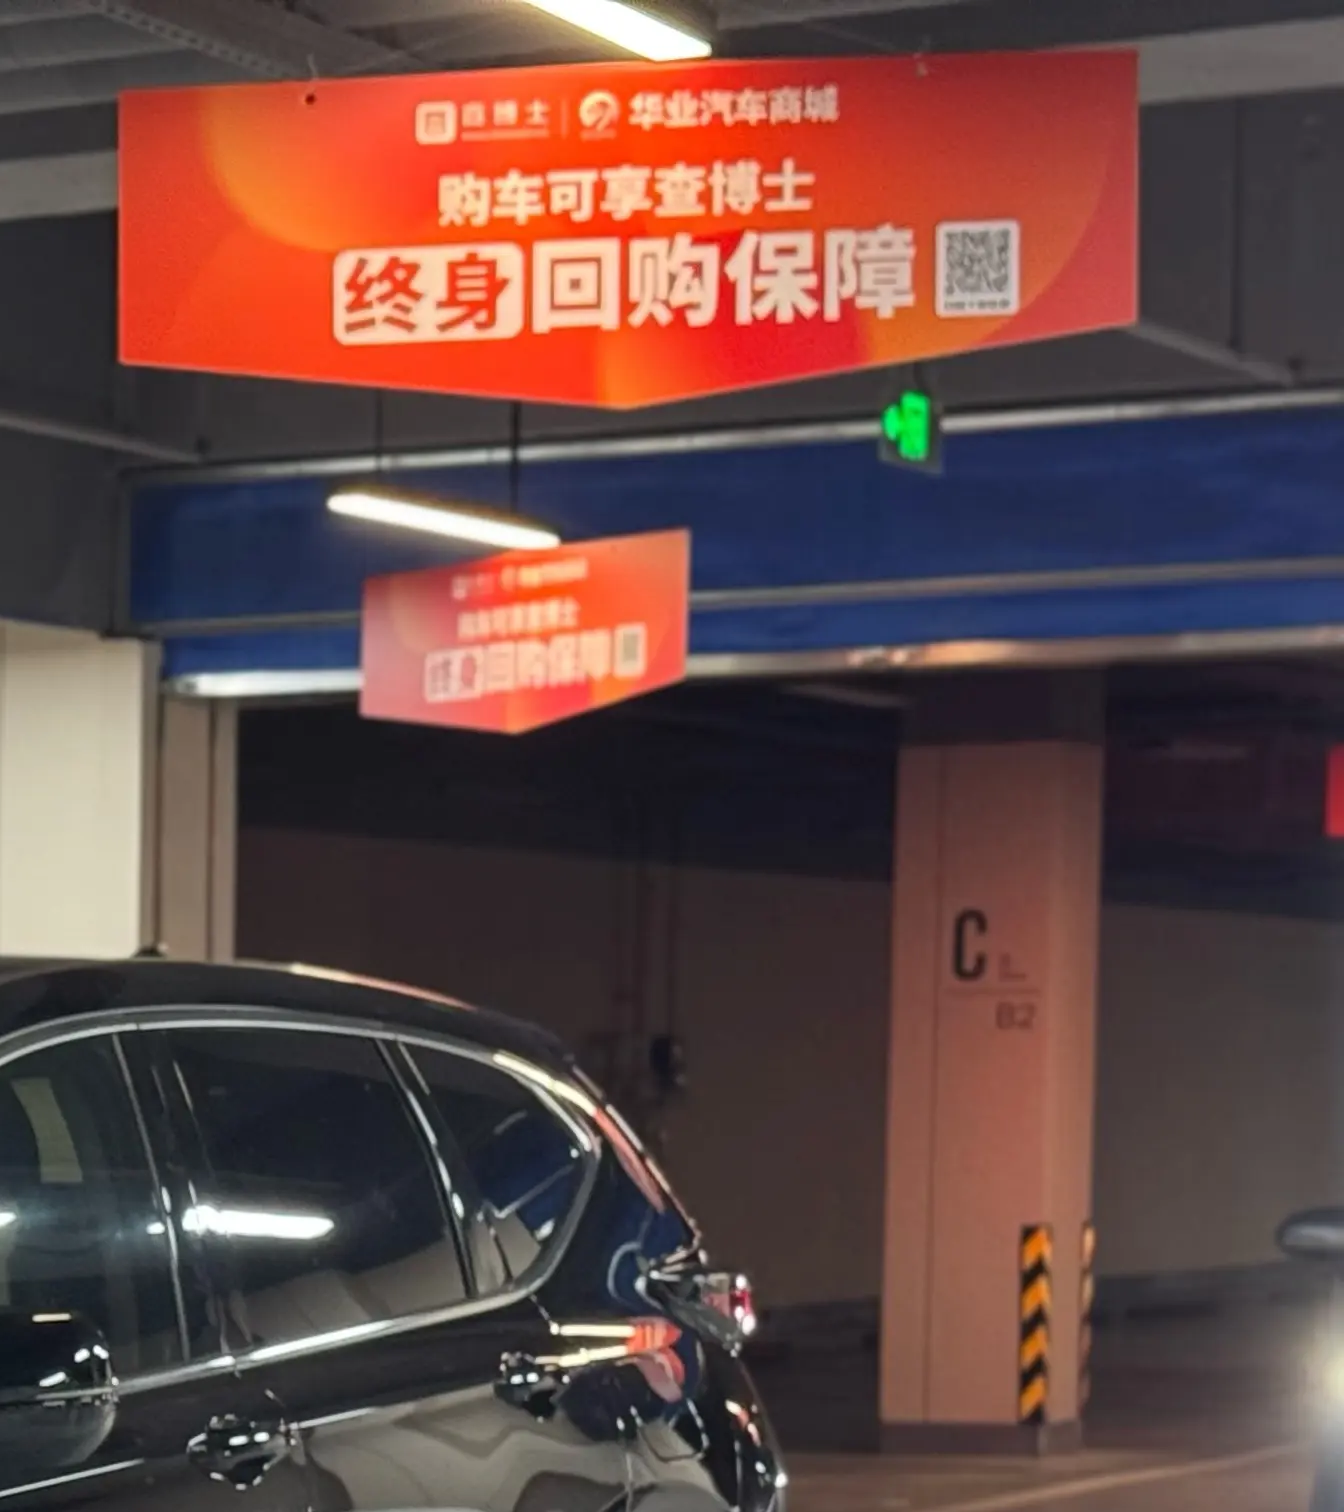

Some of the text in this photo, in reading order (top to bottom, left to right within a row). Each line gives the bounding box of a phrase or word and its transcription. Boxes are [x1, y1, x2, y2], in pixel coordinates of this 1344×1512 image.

[438, 158, 816, 227] 购车可享查博士
[342, 223, 917, 336] 终身回购保障
[952, 908, 989, 982] C
